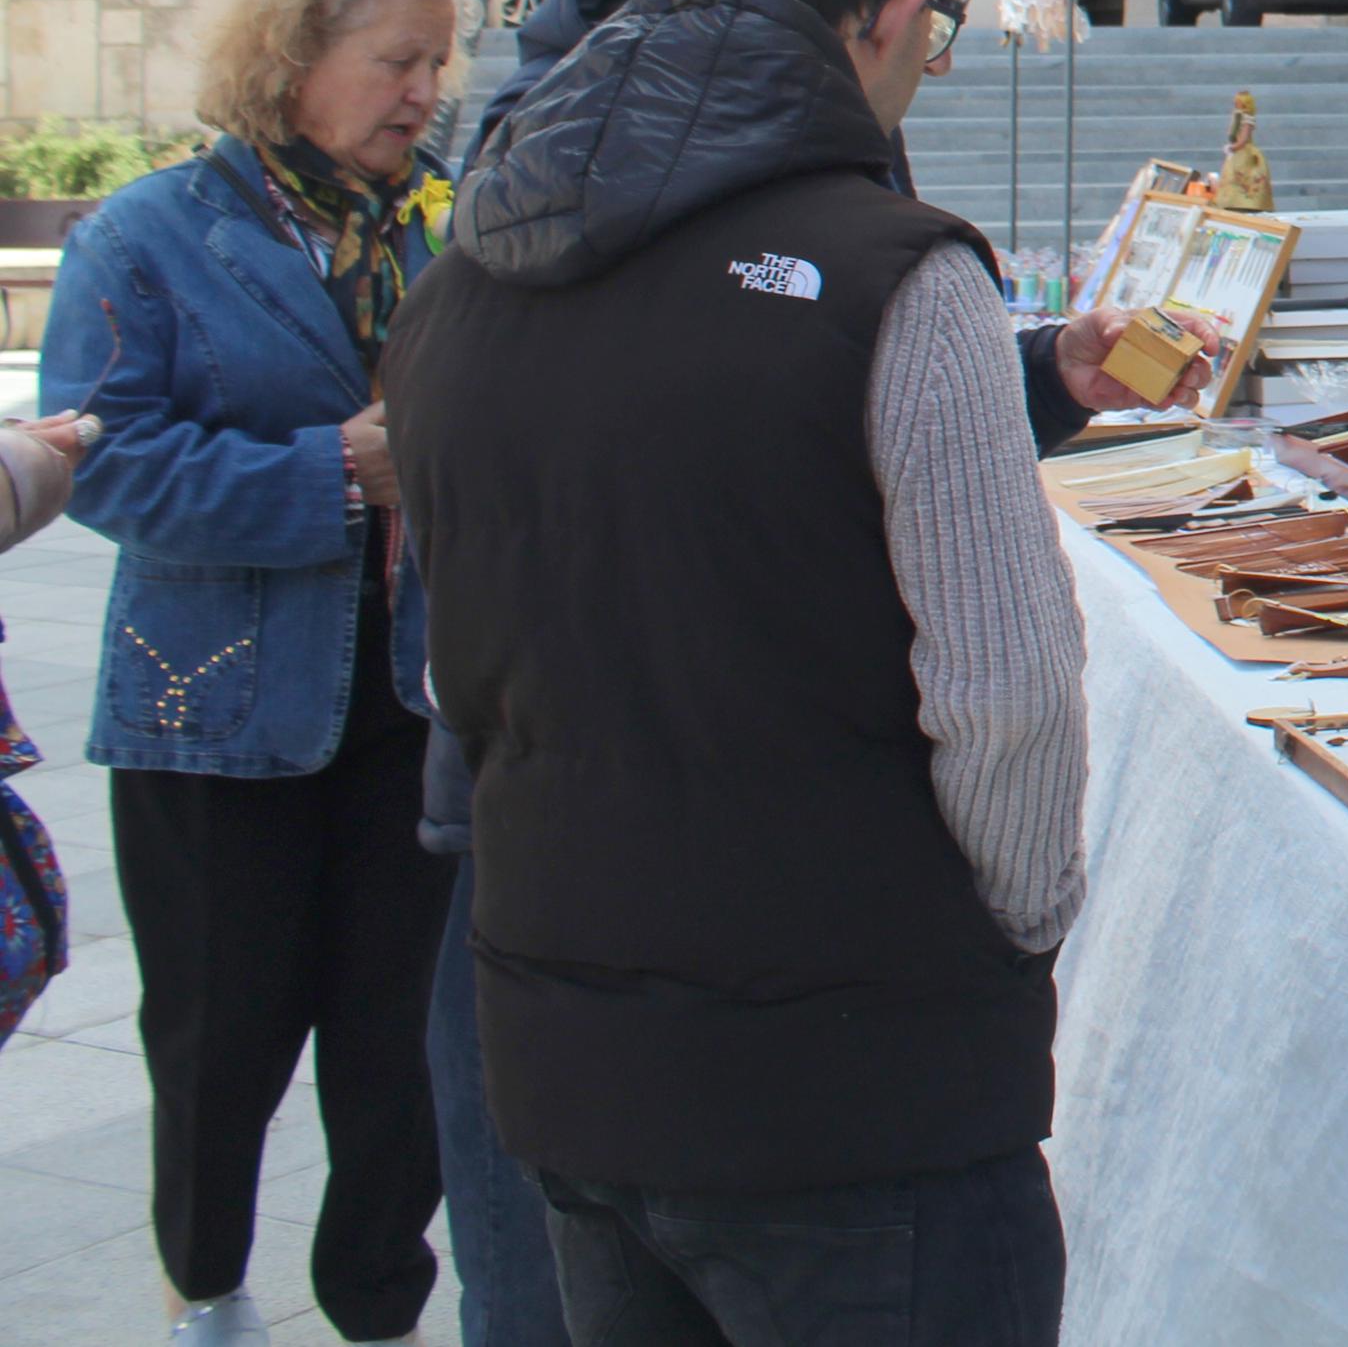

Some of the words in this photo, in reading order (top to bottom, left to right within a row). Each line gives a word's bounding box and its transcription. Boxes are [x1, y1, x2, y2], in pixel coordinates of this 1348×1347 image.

[762, 252, 797, 269] THE
[728, 261, 793, 282] NORTH
[741, 276, 787, 295] FACE
